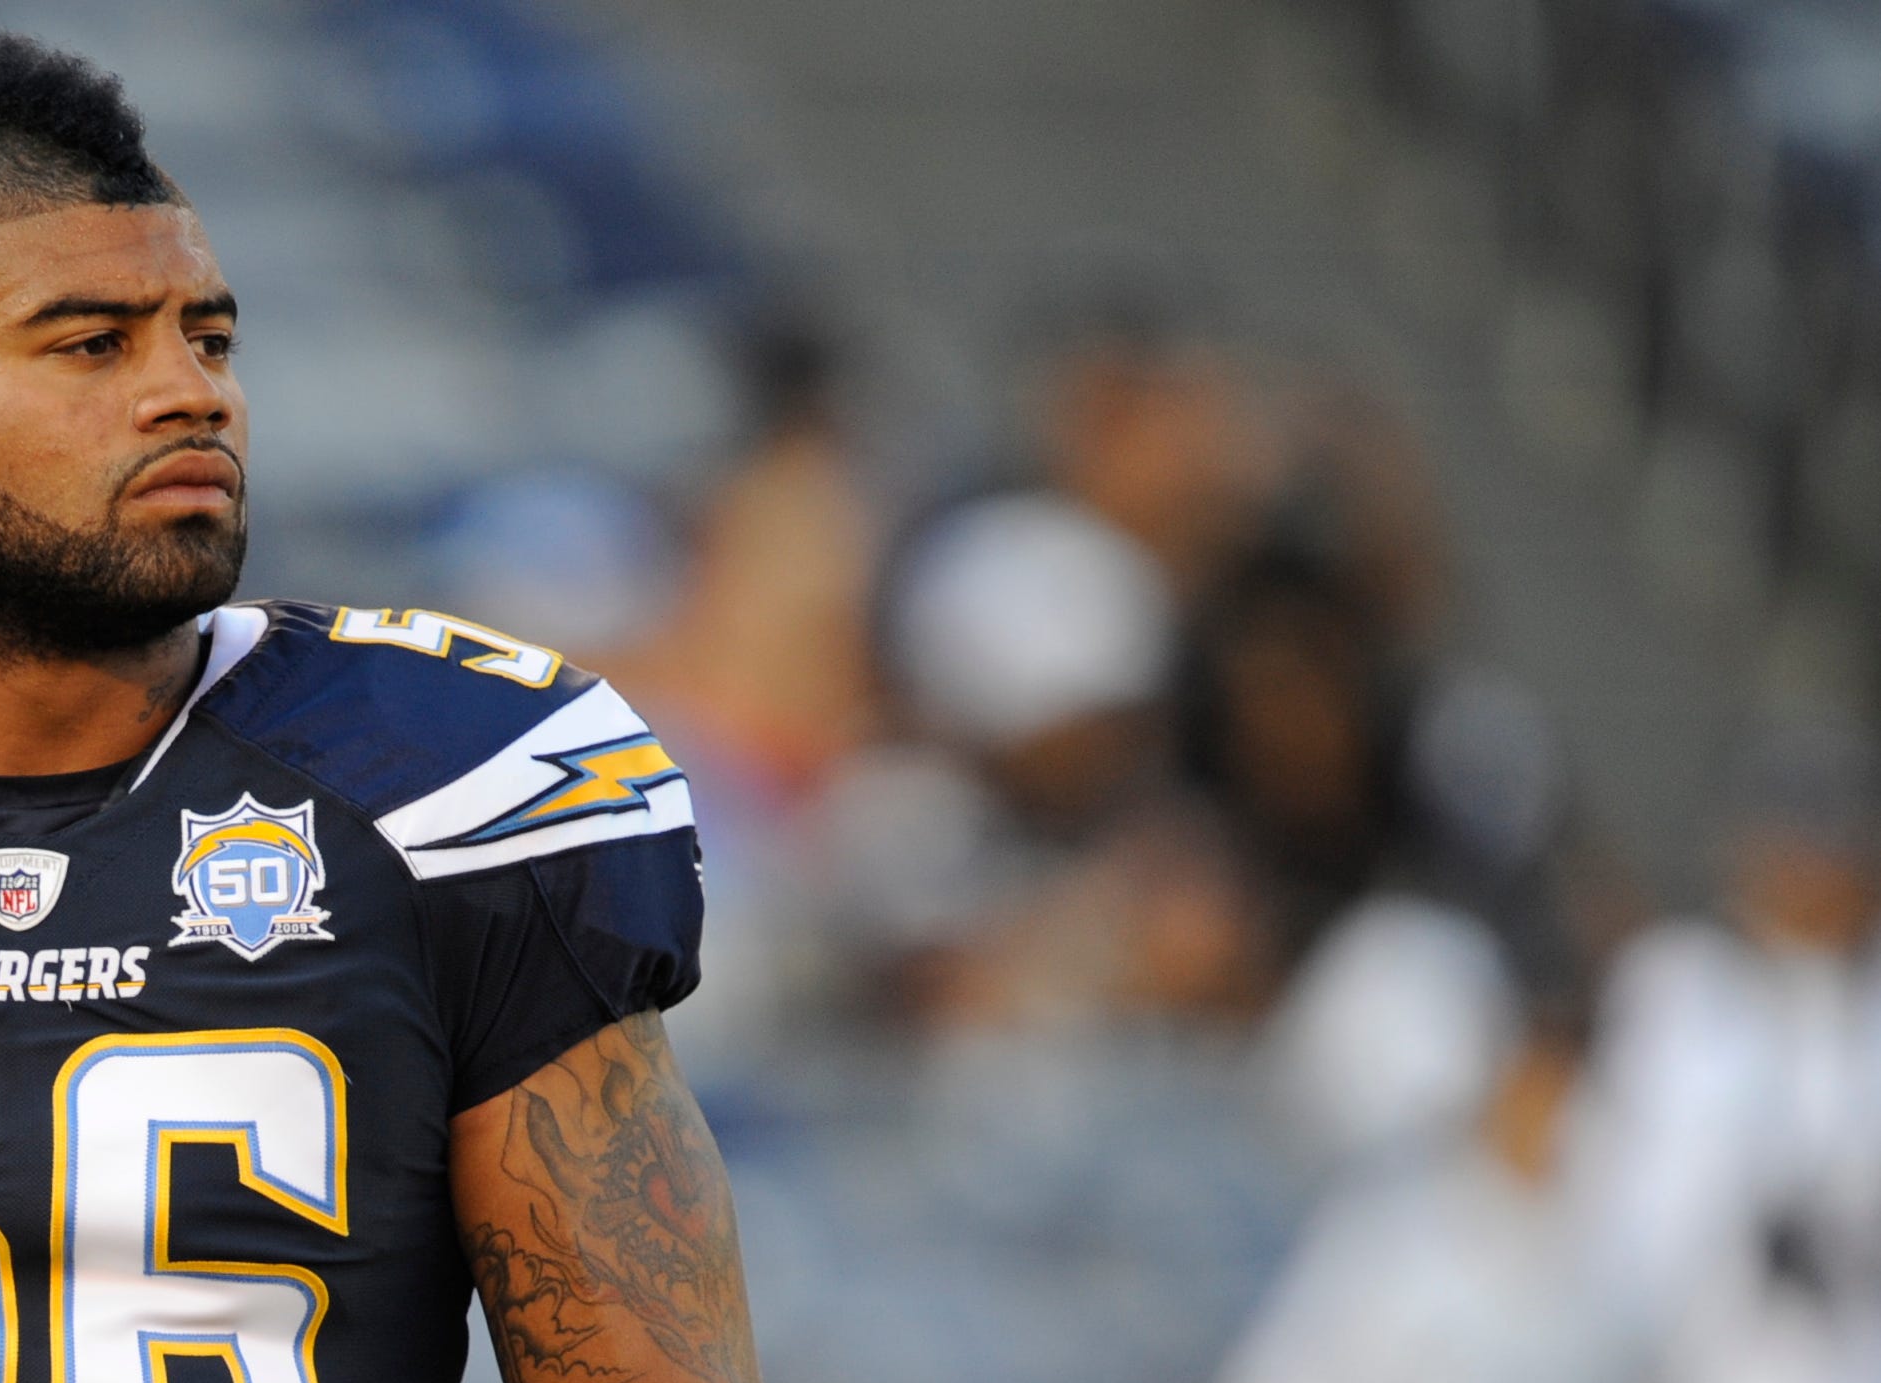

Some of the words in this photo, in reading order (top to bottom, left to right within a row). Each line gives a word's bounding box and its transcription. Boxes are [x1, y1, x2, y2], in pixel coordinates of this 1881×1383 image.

[207, 857, 291, 907] 50
[1, 889, 37, 914] NFL
[194, 925, 228, 936] 1960
[273, 923, 309, 934] 2009
